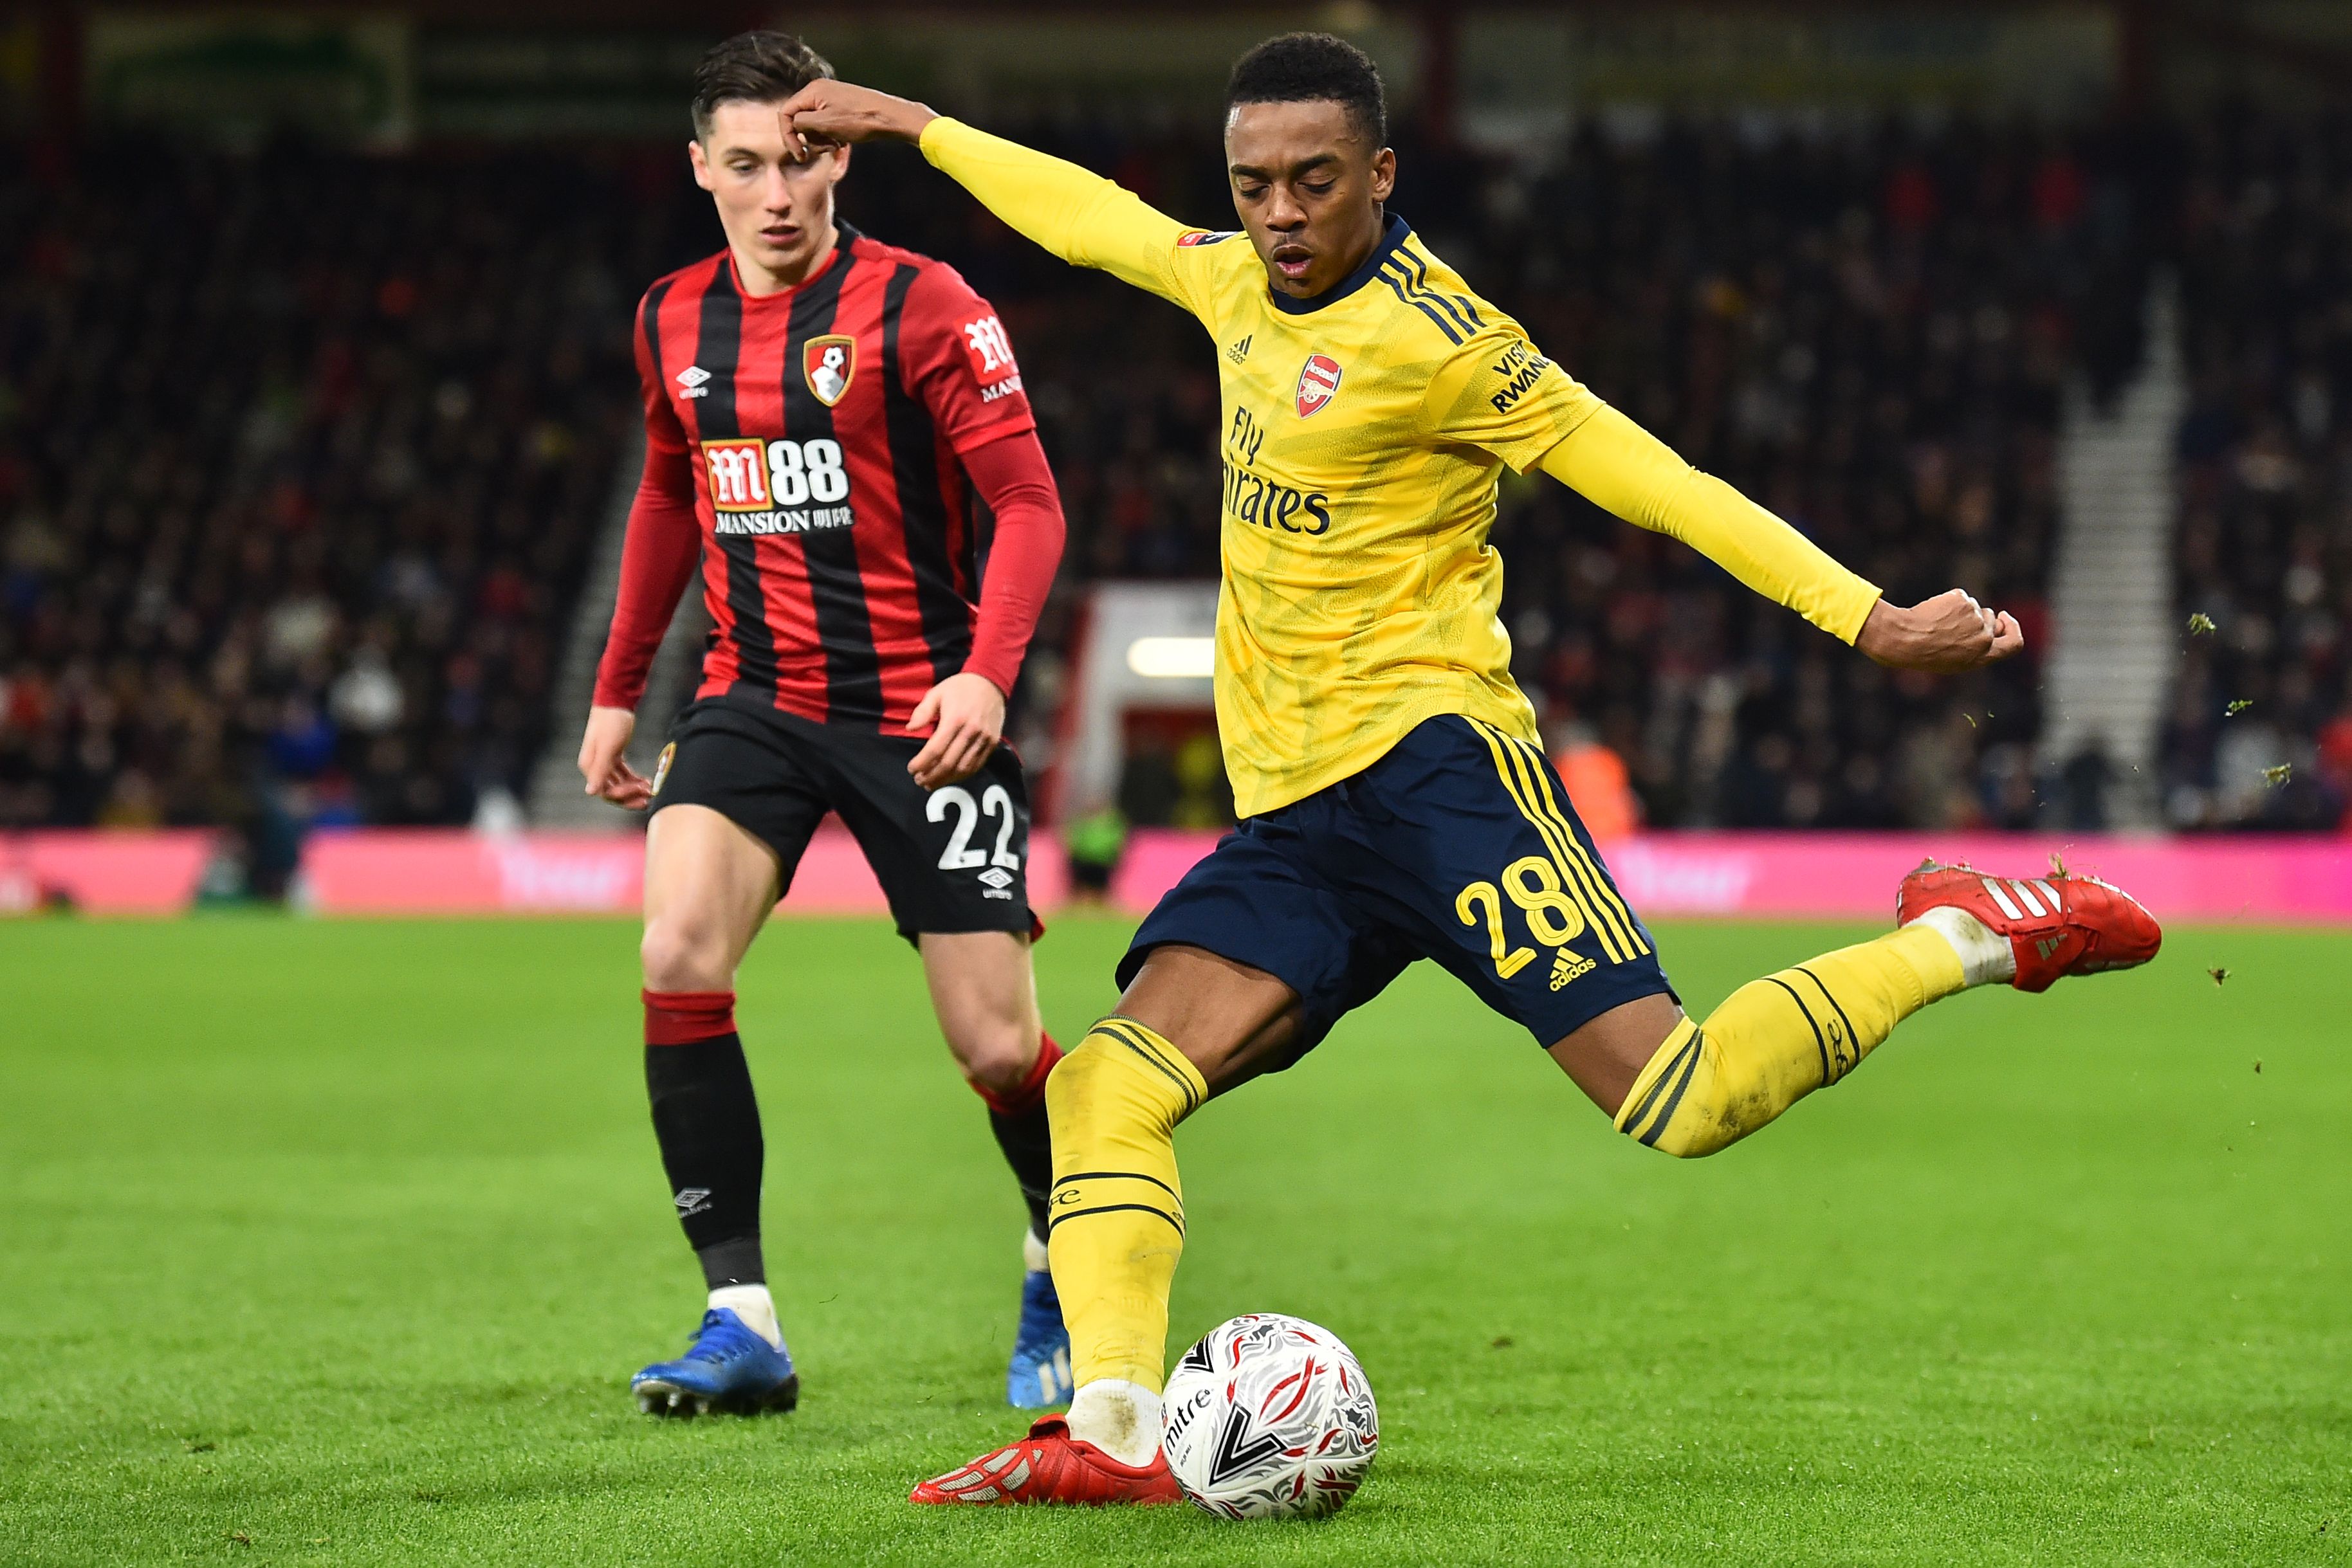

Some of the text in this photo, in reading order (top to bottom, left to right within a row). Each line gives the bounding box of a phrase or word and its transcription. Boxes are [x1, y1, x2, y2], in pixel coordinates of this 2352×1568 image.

[1226, 347, 1246, 365] adidas
[1307, 361, 1337, 383] Arsenal
[1491, 339, 1529, 377] VISIT
[1229, 405, 1264, 467] Fly
[715, 509, 811, 534] MANSION
[926, 784, 1019, 871] 22
[1455, 856, 1585, 980] 28
[1548, 958, 1597, 992] adidas
[1165, 1389, 1212, 1457] mitre
